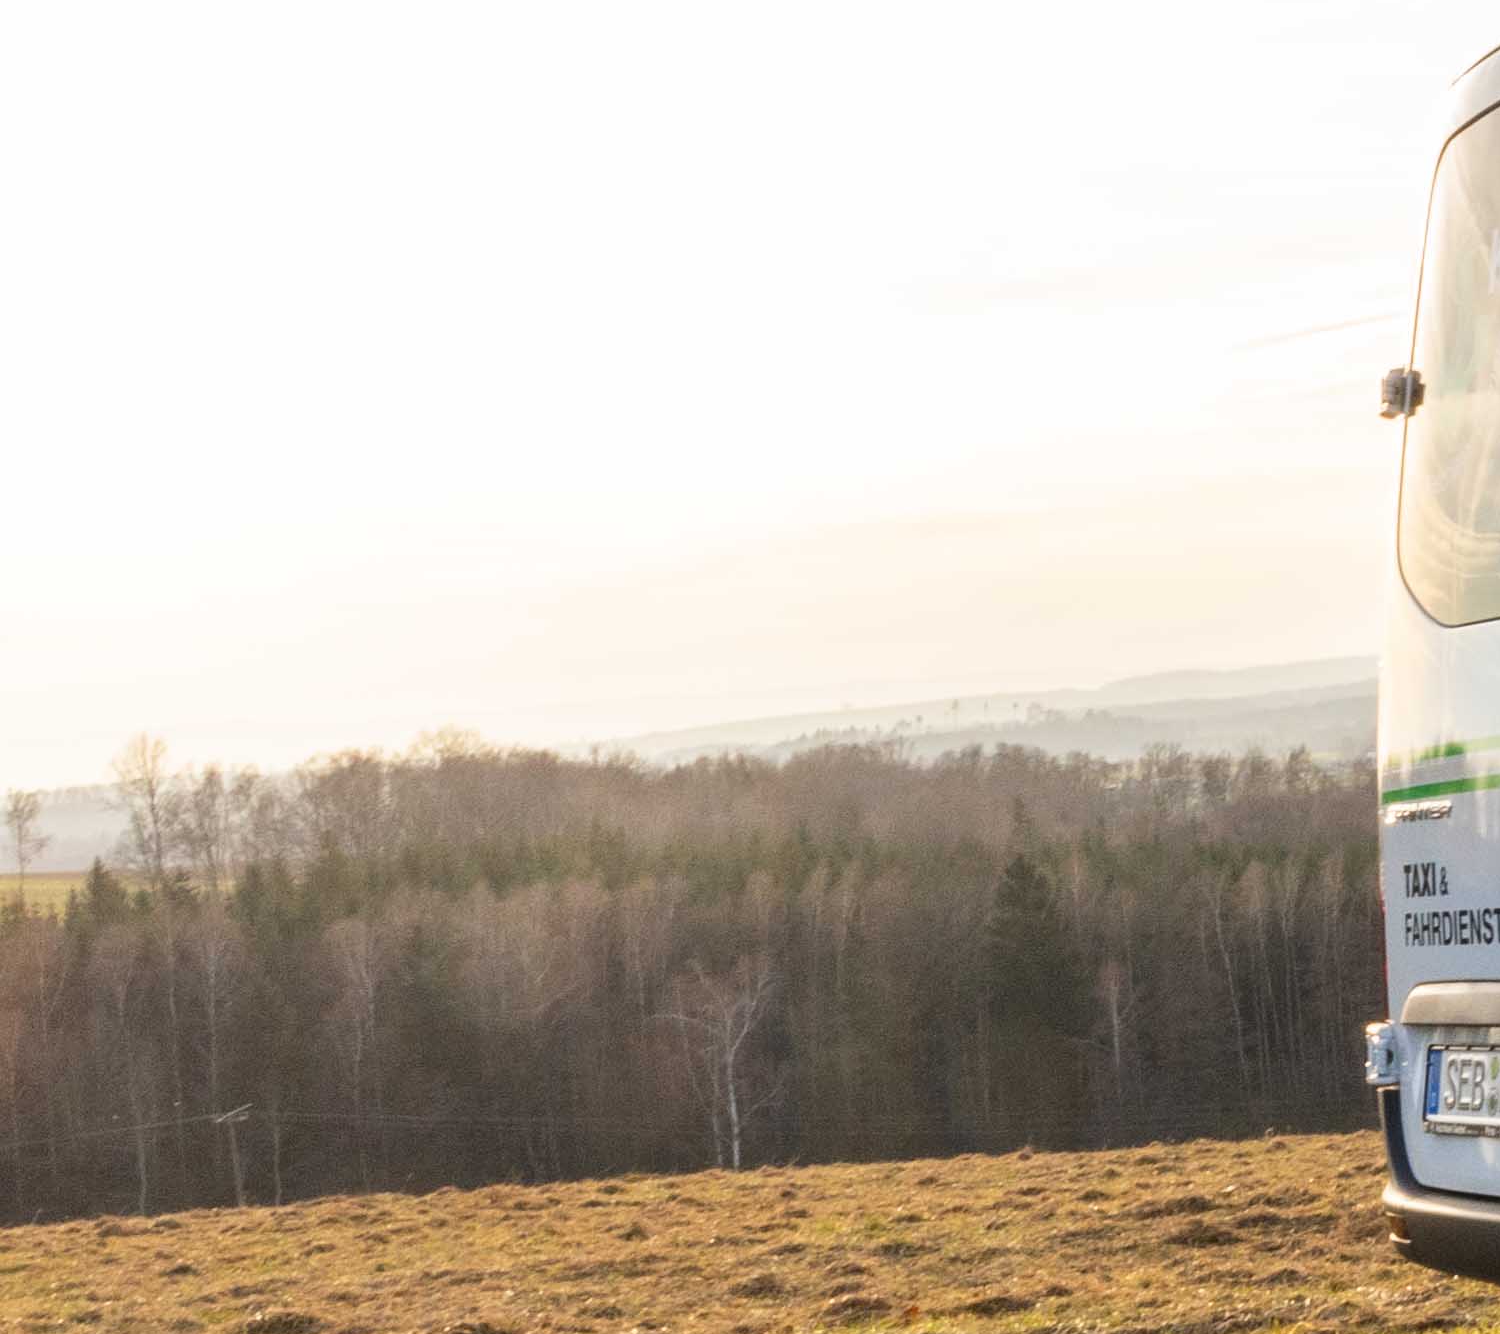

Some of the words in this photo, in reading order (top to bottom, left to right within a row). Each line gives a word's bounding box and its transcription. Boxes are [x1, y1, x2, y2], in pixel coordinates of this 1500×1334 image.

[1403, 862, 1436, 897] TAXI
[1439, 867, 1449, 896] &
[1443, 1058, 1486, 1112] SEB
